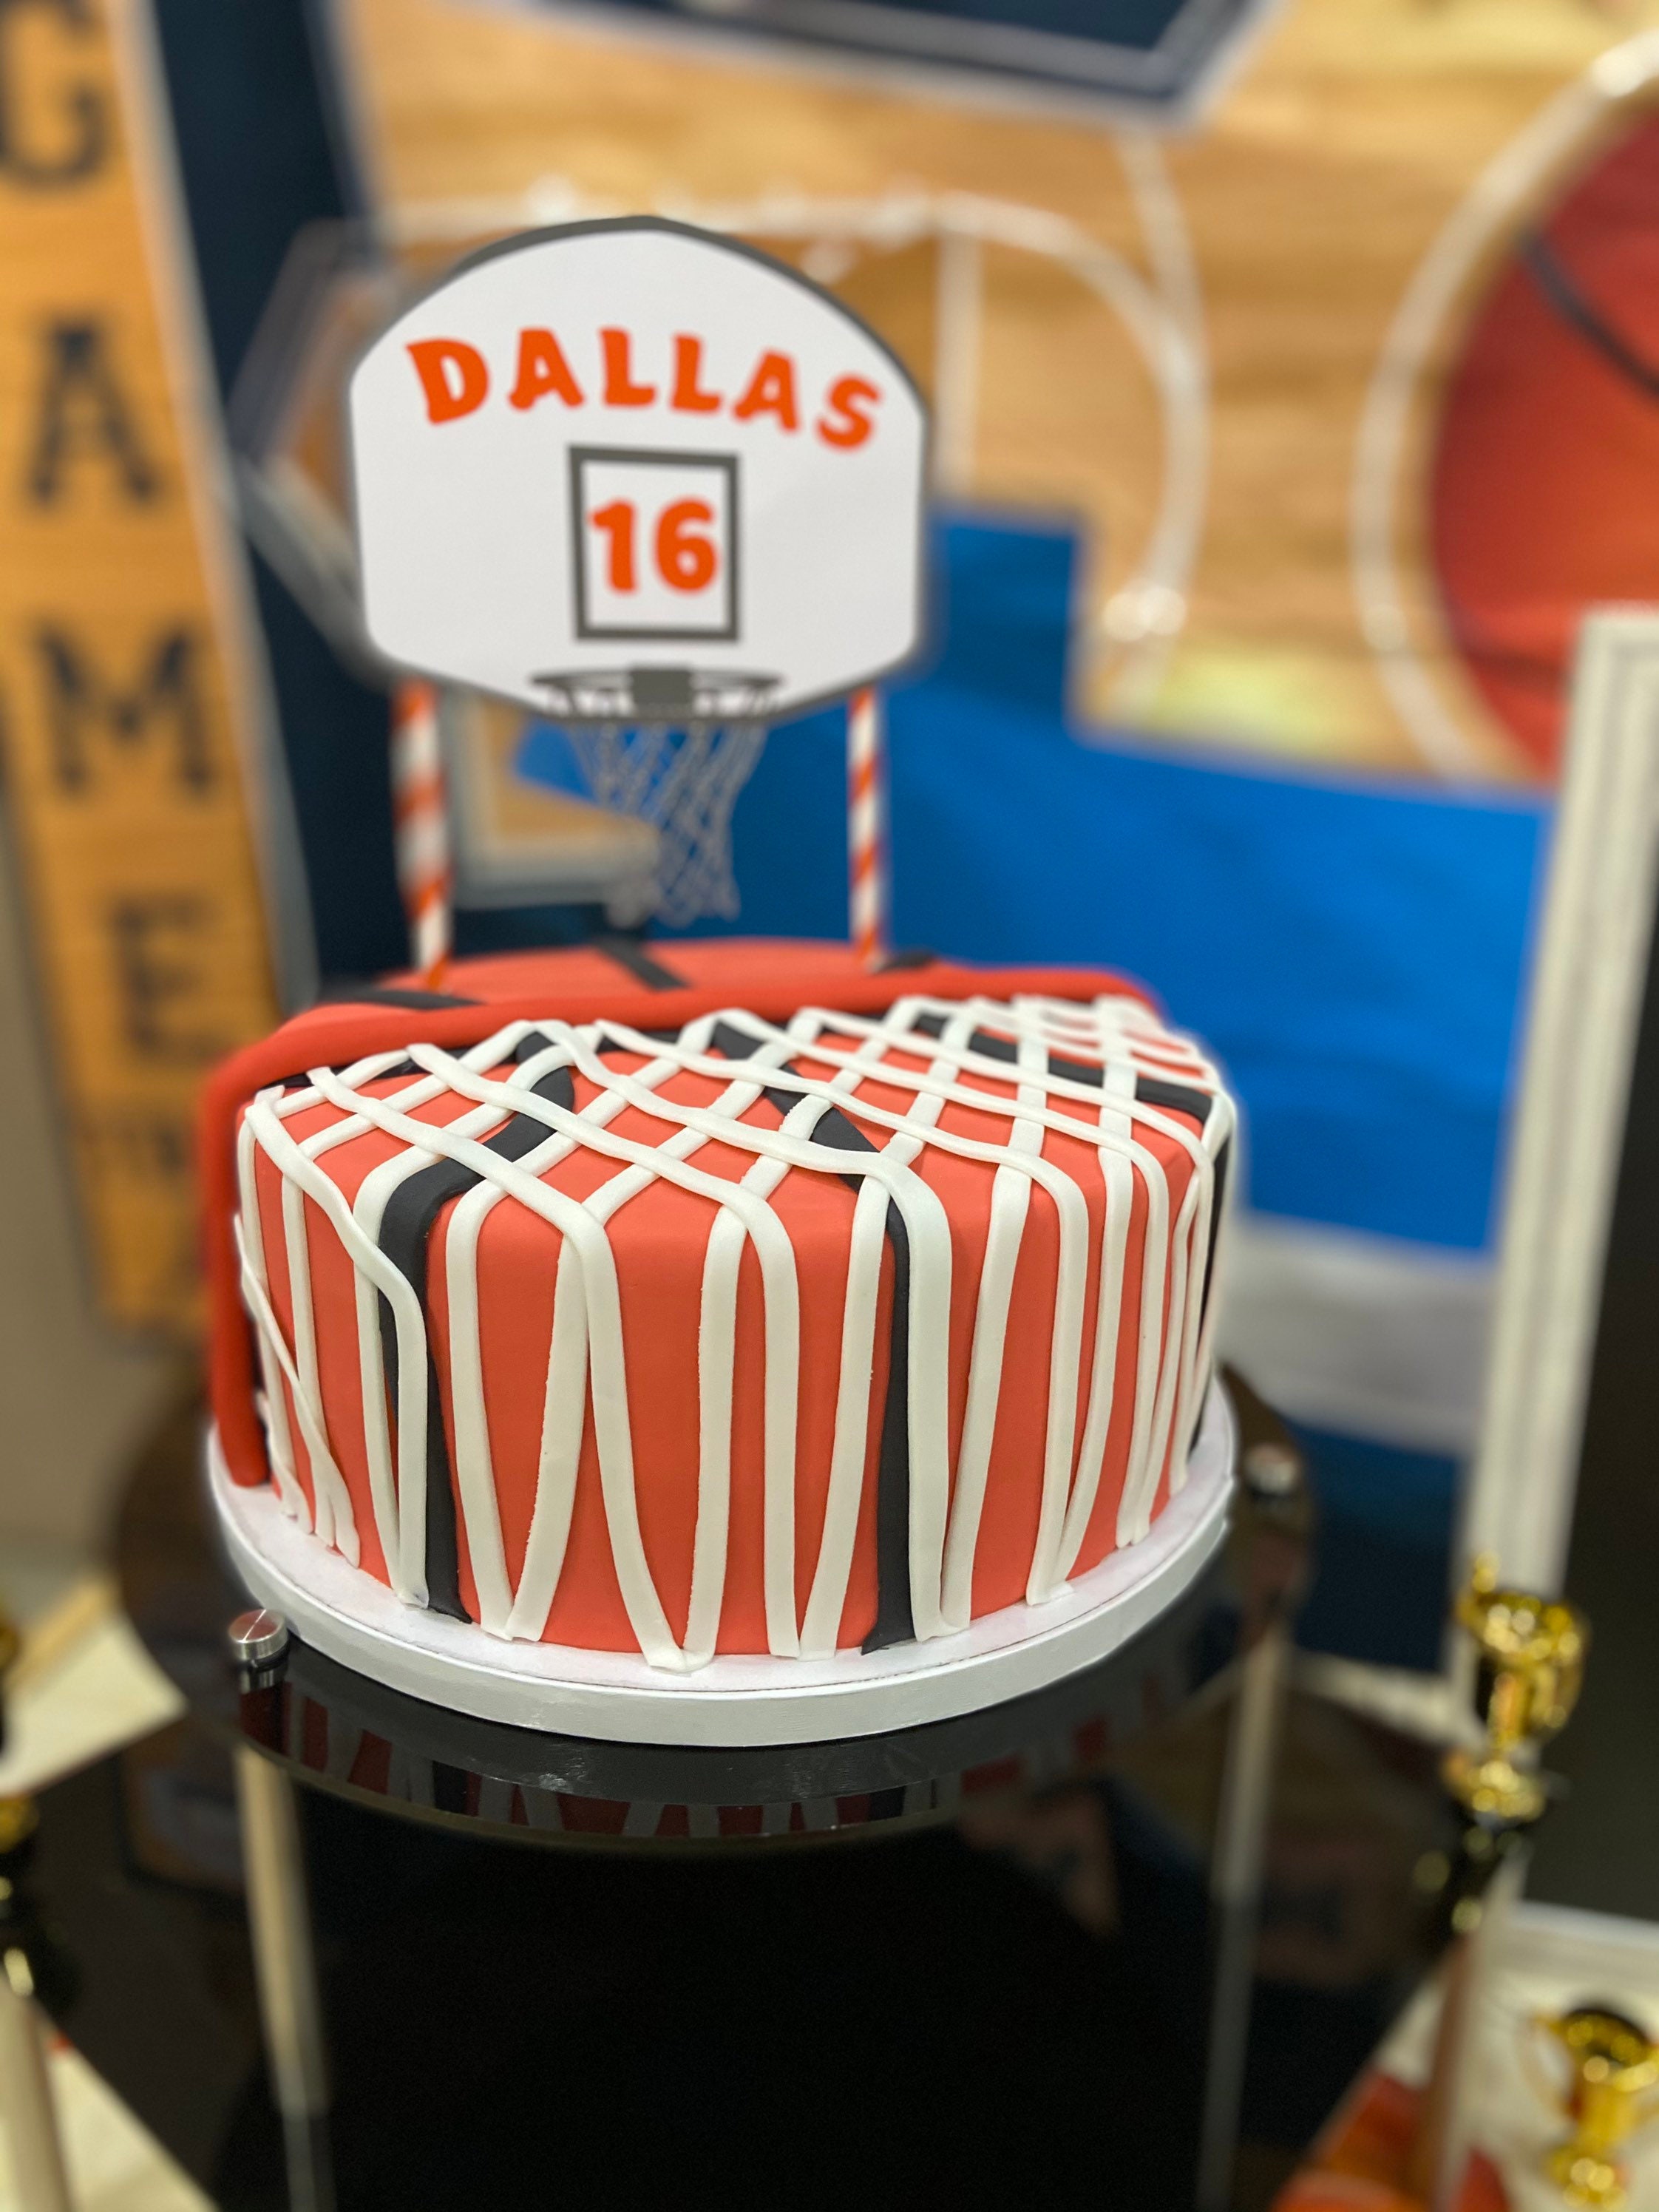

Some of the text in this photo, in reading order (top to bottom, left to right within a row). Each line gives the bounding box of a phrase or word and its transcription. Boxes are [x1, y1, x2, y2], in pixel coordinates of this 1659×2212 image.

[406, 326, 882, 450] DALLAS
[0, 0, 223, 1061] GAME
[590, 499, 719, 594] 16
